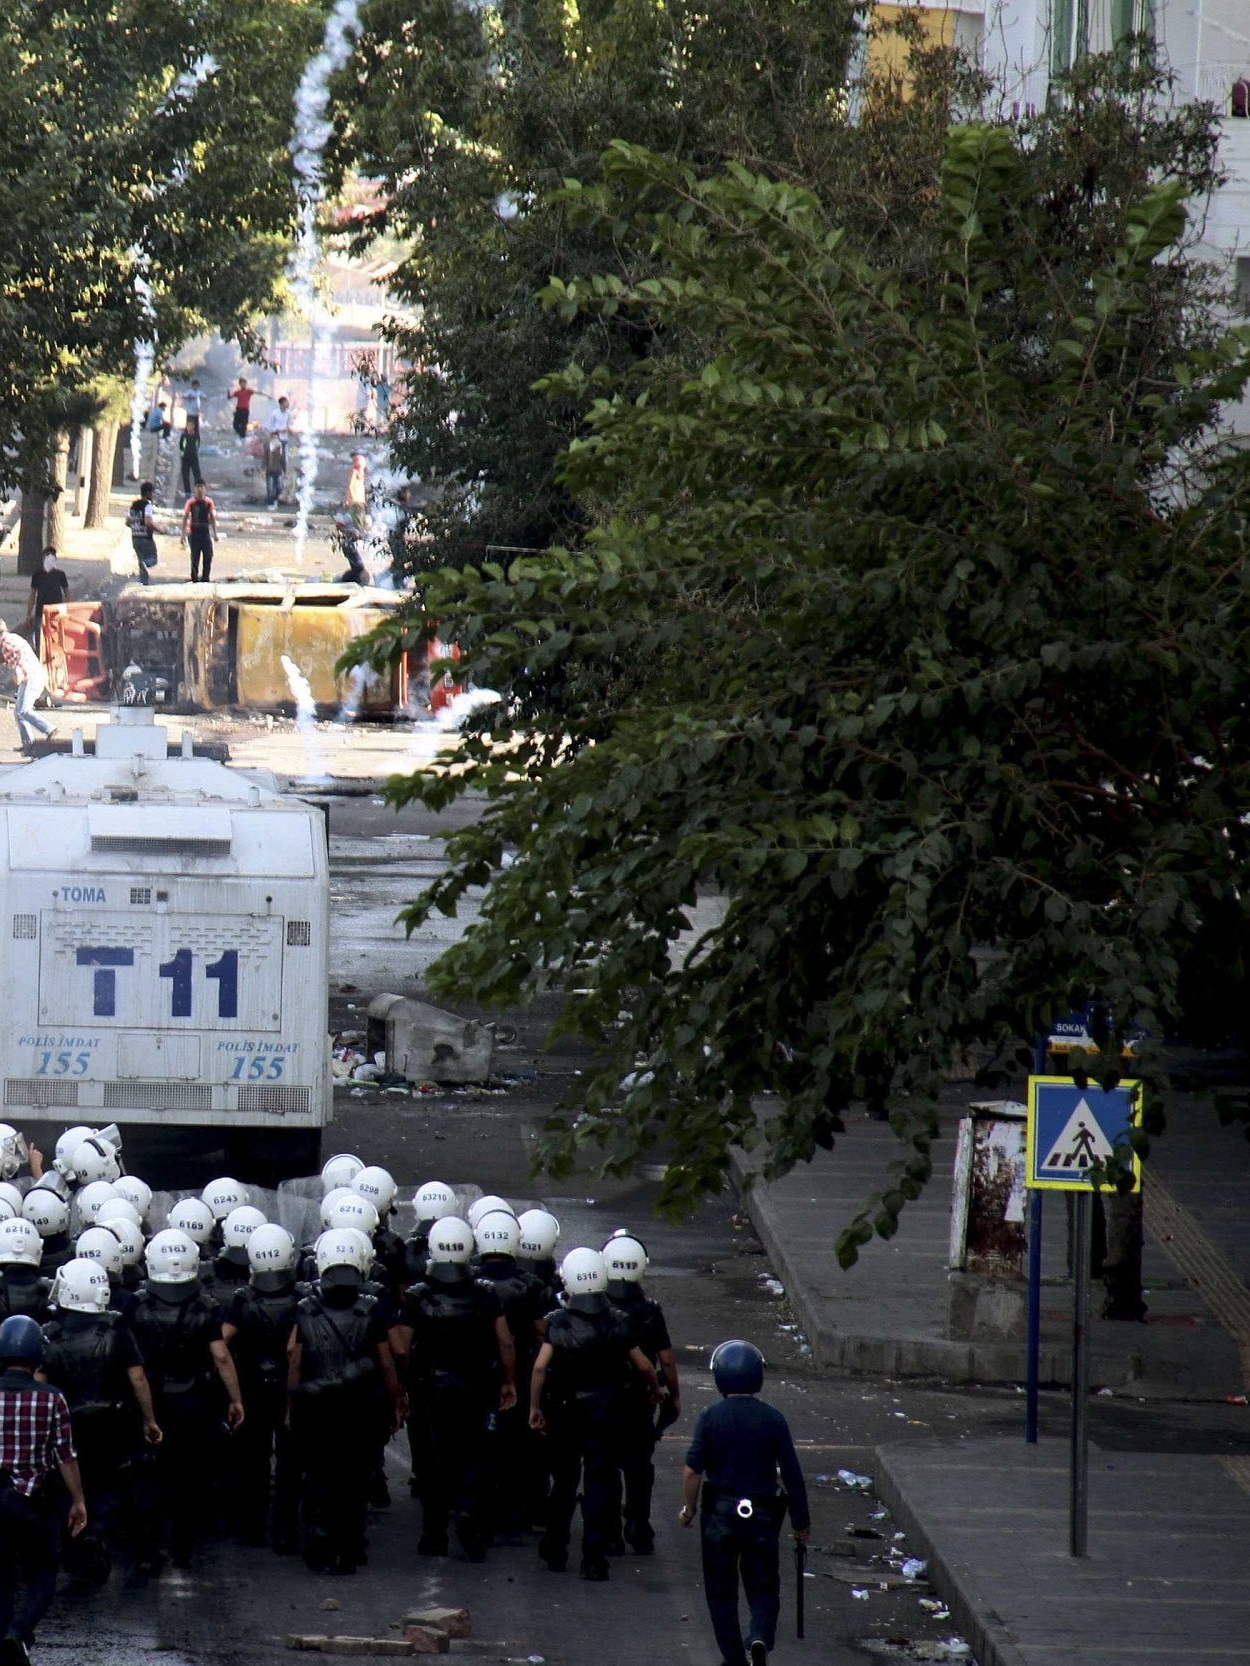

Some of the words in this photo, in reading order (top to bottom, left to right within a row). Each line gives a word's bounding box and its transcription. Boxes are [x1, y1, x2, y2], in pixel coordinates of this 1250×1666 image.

[61, 886, 106, 903] TOMA
[76, 946, 134, 1017] T
[159, 948, 238, 1018] 11
[18, 1035, 55, 1047] POLİS
[57, 1034, 101, 1048] İMDAT
[217, 1040, 255, 1053] POLİS
[257, 1039, 301, 1054] İMDAT
[35, 1051, 91, 1076] 155
[230, 1056, 286, 1080] 155
[214, 1194, 239, 1205] 6243
[339, 1205, 363, 1215] 6214
[179, 1219, 204, 1231] 6169
[484, 1231, 510, 1241] 6132
[255, 1249, 280, 1259] 6112
